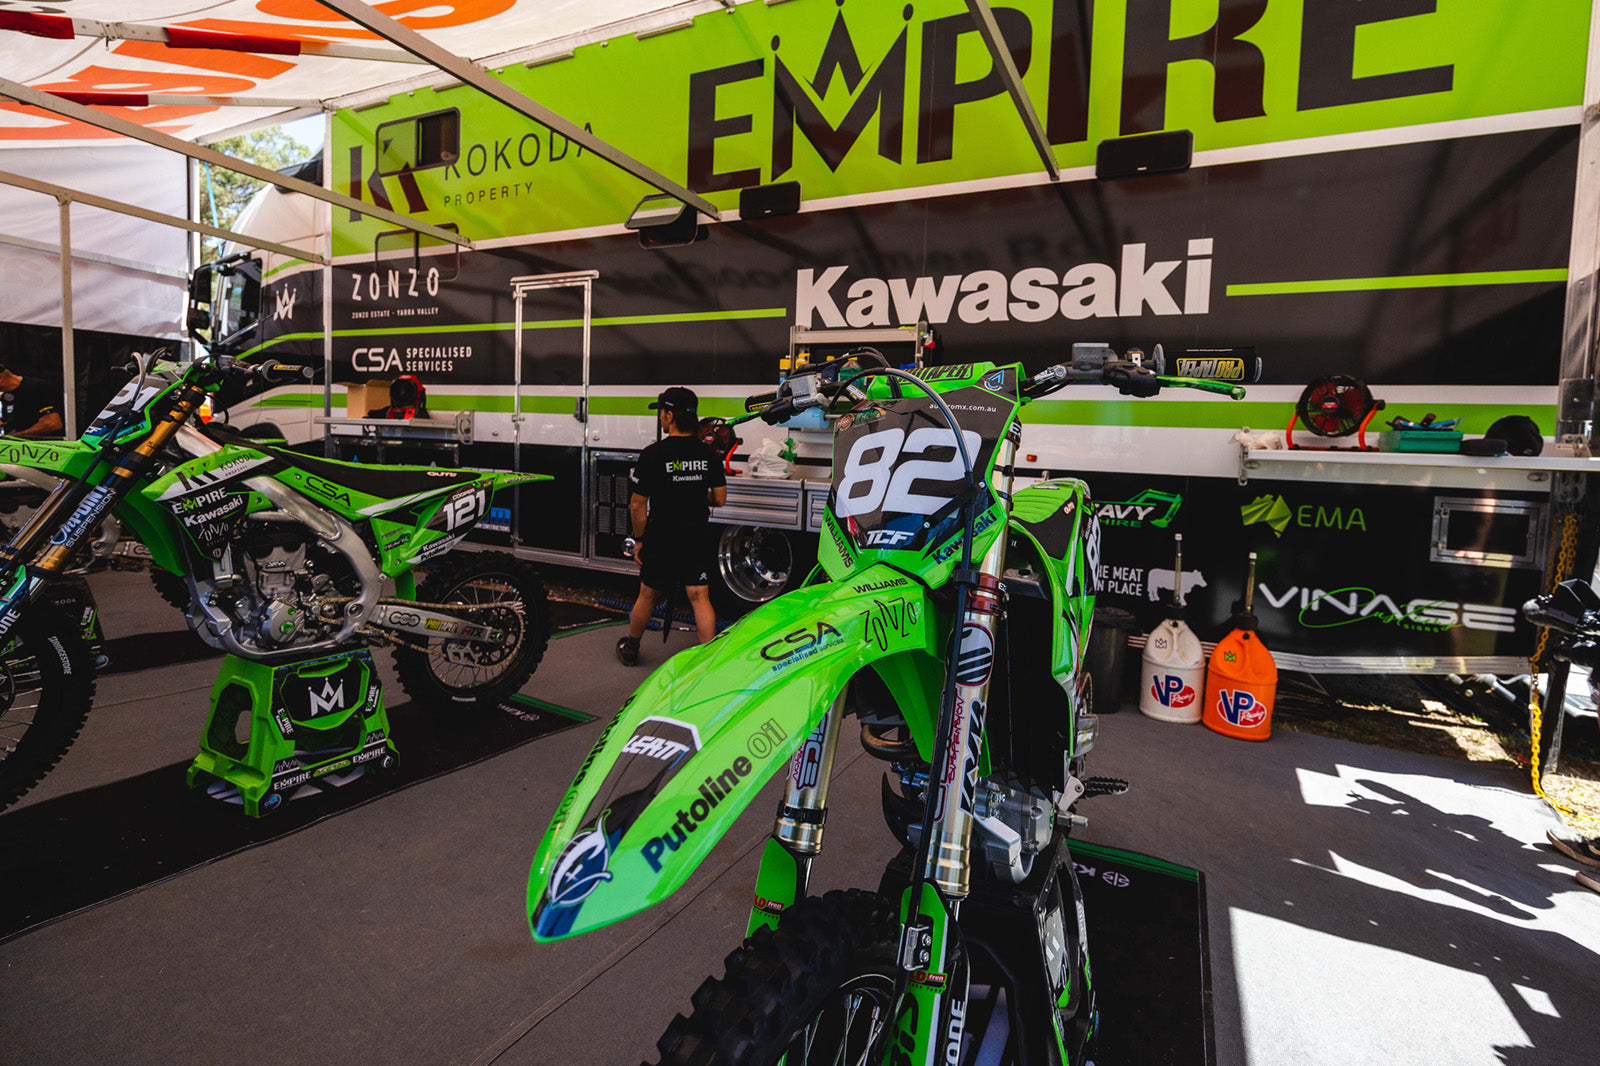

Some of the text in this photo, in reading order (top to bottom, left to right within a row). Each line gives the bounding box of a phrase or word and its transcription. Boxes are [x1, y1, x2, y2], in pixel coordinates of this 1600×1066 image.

[688, 0, 1455, 194] EMPIRE
[444, 182, 533, 207] PROPERTY
[352, 267, 440, 301] ZONZO
[796, 238, 1213, 328] Kawasaki
[352, 311, 369, 319] ZONZO
[370, 310, 390, 318] ESTATE
[396, 308, 415, 316] YARRA
[417, 307, 439, 315] VALLEY
[352, 347, 404, 372] CSA
[406, 346, 472, 358] SPECIALISED
[406, 360, 454, 372] SERVICES
[929, 403, 997, 413] auromx.com.au
[0, 444, 59, 464] ZONZO
[219, 452, 256, 471] KOKODA
[665, 459, 708, 473] EMPIRE
[673, 474, 702, 482] Kawasaki
[835, 427, 982, 519] 82
[171, 487, 228, 514] EMPIRE
[306, 476, 351, 508] CSA
[452, 488, 475, 500] COOPER
[66, 490, 116, 548] SUSPENSION
[183, 495, 243, 527] Kawasaki
[443, 489, 486, 532] 121
[1297, 504, 1367, 532] EMA
[422, 533, 456, 551] Kawasaki
[825, 513, 854, 568] WILLIAMS
[866, 530, 914, 545] TCF
[931, 509, 998, 565] Kawaki
[853, 578, 908, 594] WILLIAMS
[1096, 580, 1143, 596] N PLACE
[1113, 567, 1144, 582] MEAT
[1258, 582, 1517, 633] VINAGE
[859, 597, 918, 651] ZONZO
[1403, 623, 1439, 633] SIGNS
[760, 621, 842, 662] CSA
[772, 638, 844, 671] specialised services
[49, 635, 72, 676] BRIDGESTONE
[365, 685, 378, 712] EMPIRE
[1153, 675, 1183, 707] VP
[1219, 689, 1255, 725] VP
[277, 707, 294, 735] EMPIRE
[352, 746, 386, 763] EMPIRE
[274, 771, 312, 791] EMPIRE
[640, 717, 788, 874] Putoline Oil
